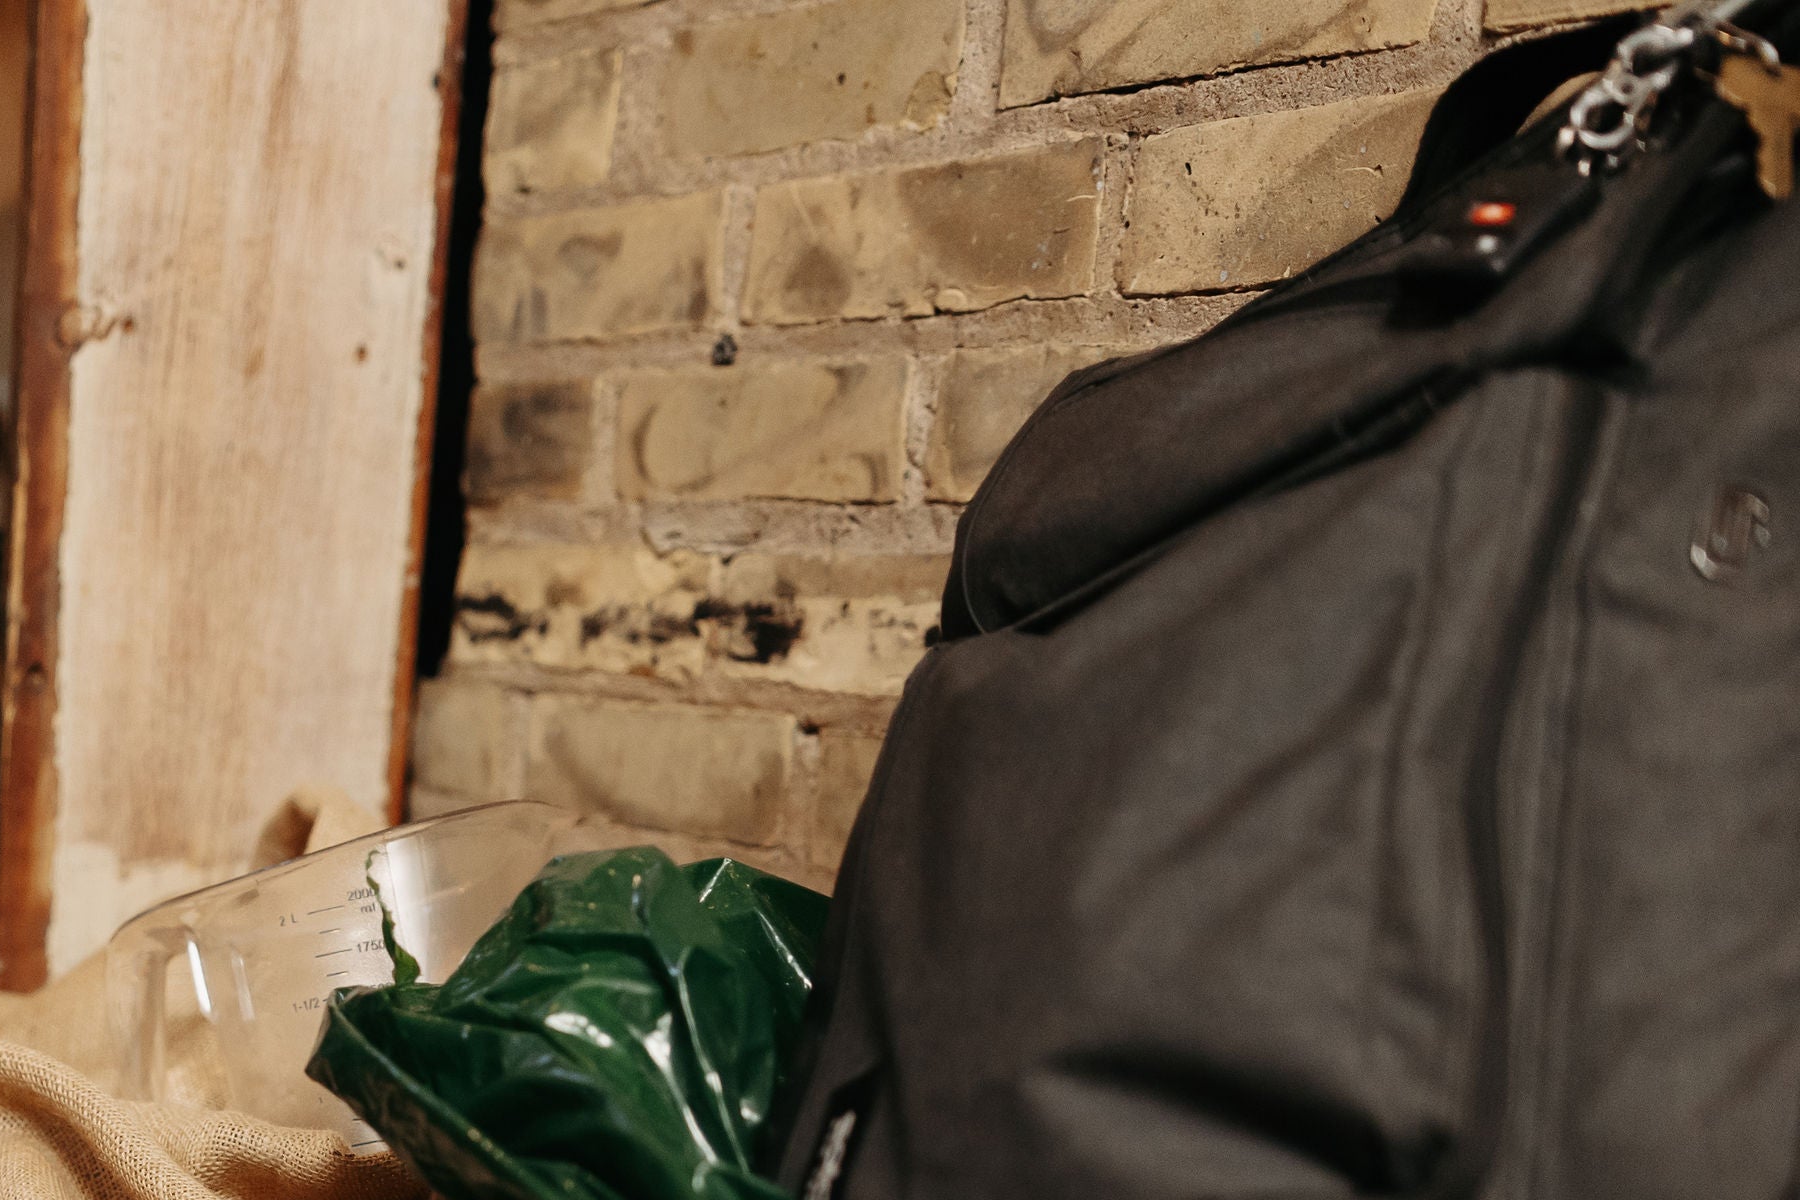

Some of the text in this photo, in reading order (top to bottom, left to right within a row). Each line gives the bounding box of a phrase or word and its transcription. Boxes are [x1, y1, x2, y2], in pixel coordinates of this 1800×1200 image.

[360, 902, 377, 914] ml
[279, 913, 298, 927] 2 L
